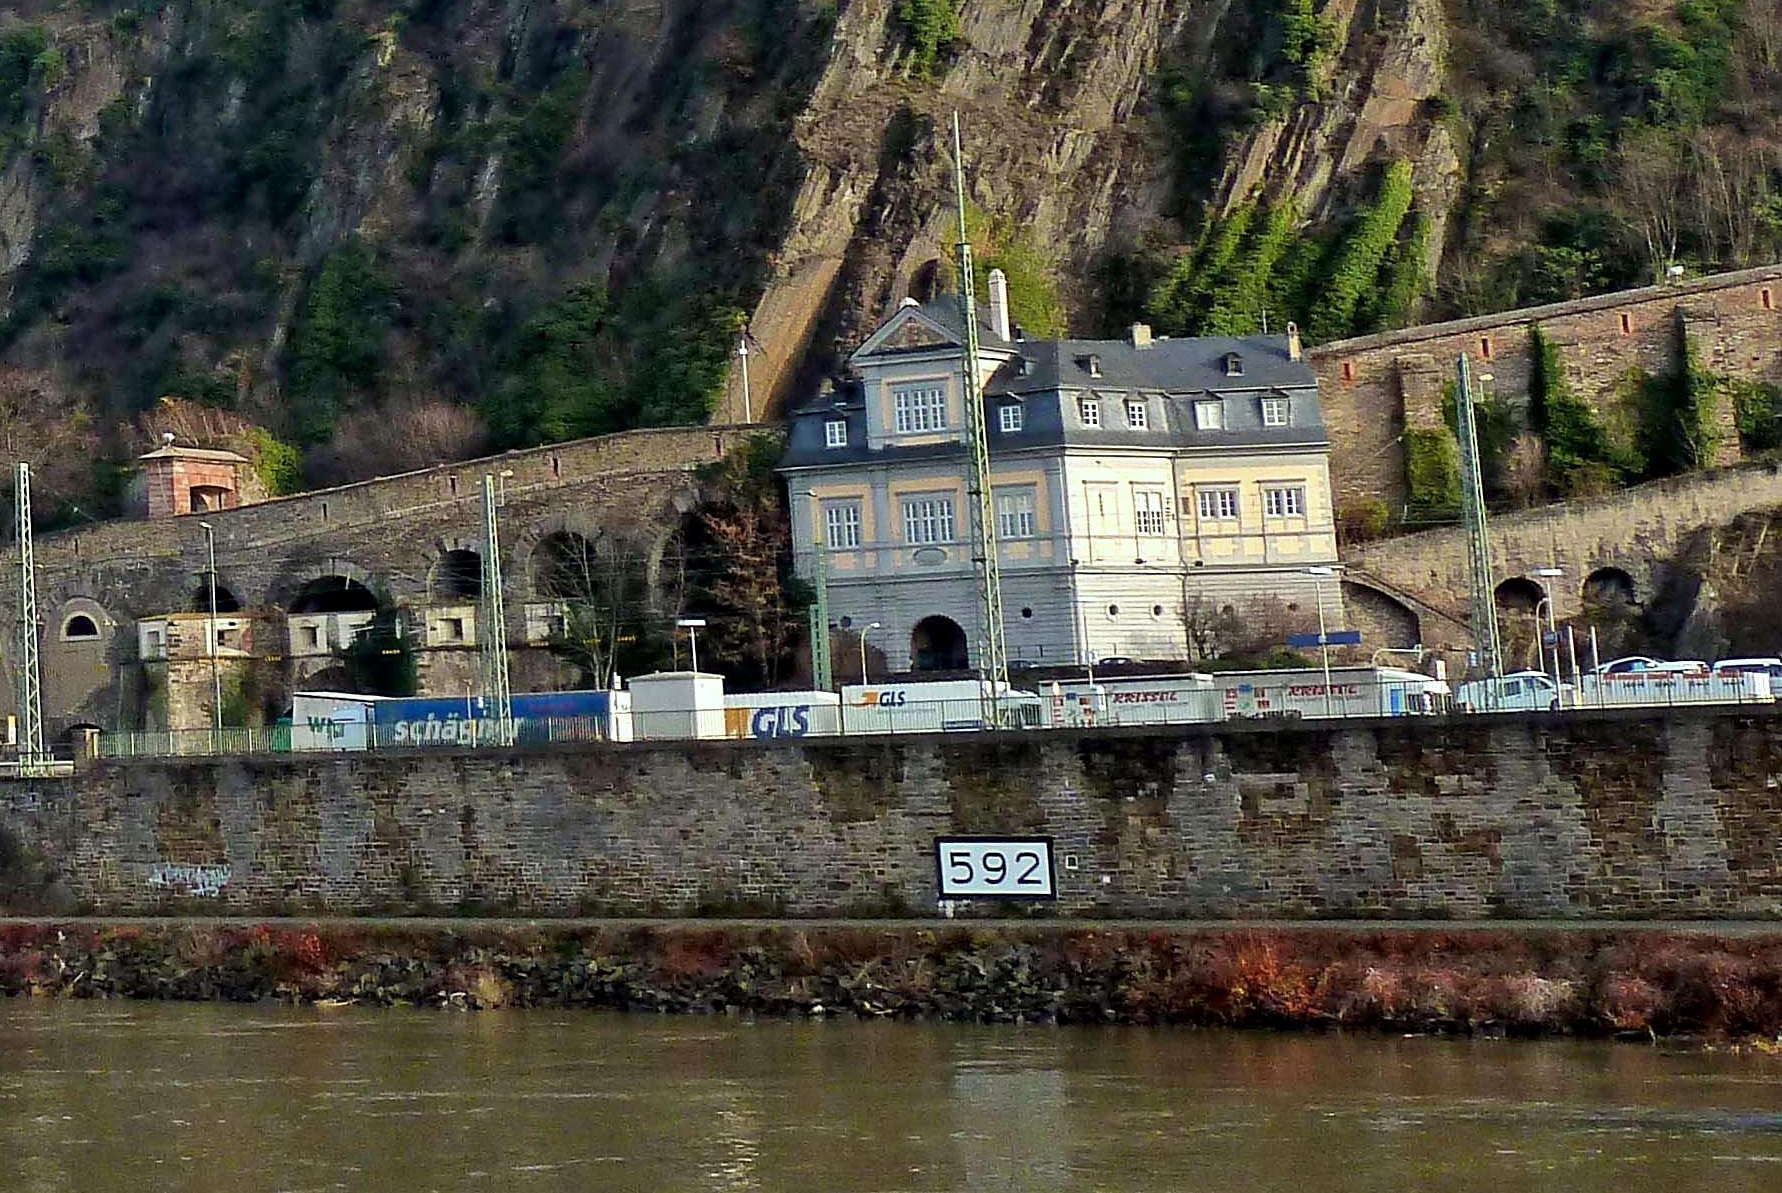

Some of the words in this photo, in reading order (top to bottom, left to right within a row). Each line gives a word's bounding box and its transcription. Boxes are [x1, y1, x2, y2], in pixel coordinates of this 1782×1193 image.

[880, 691, 906, 707] GLS
[752, 705, 810, 739] GLS
[949, 851, 1043, 885] 592
